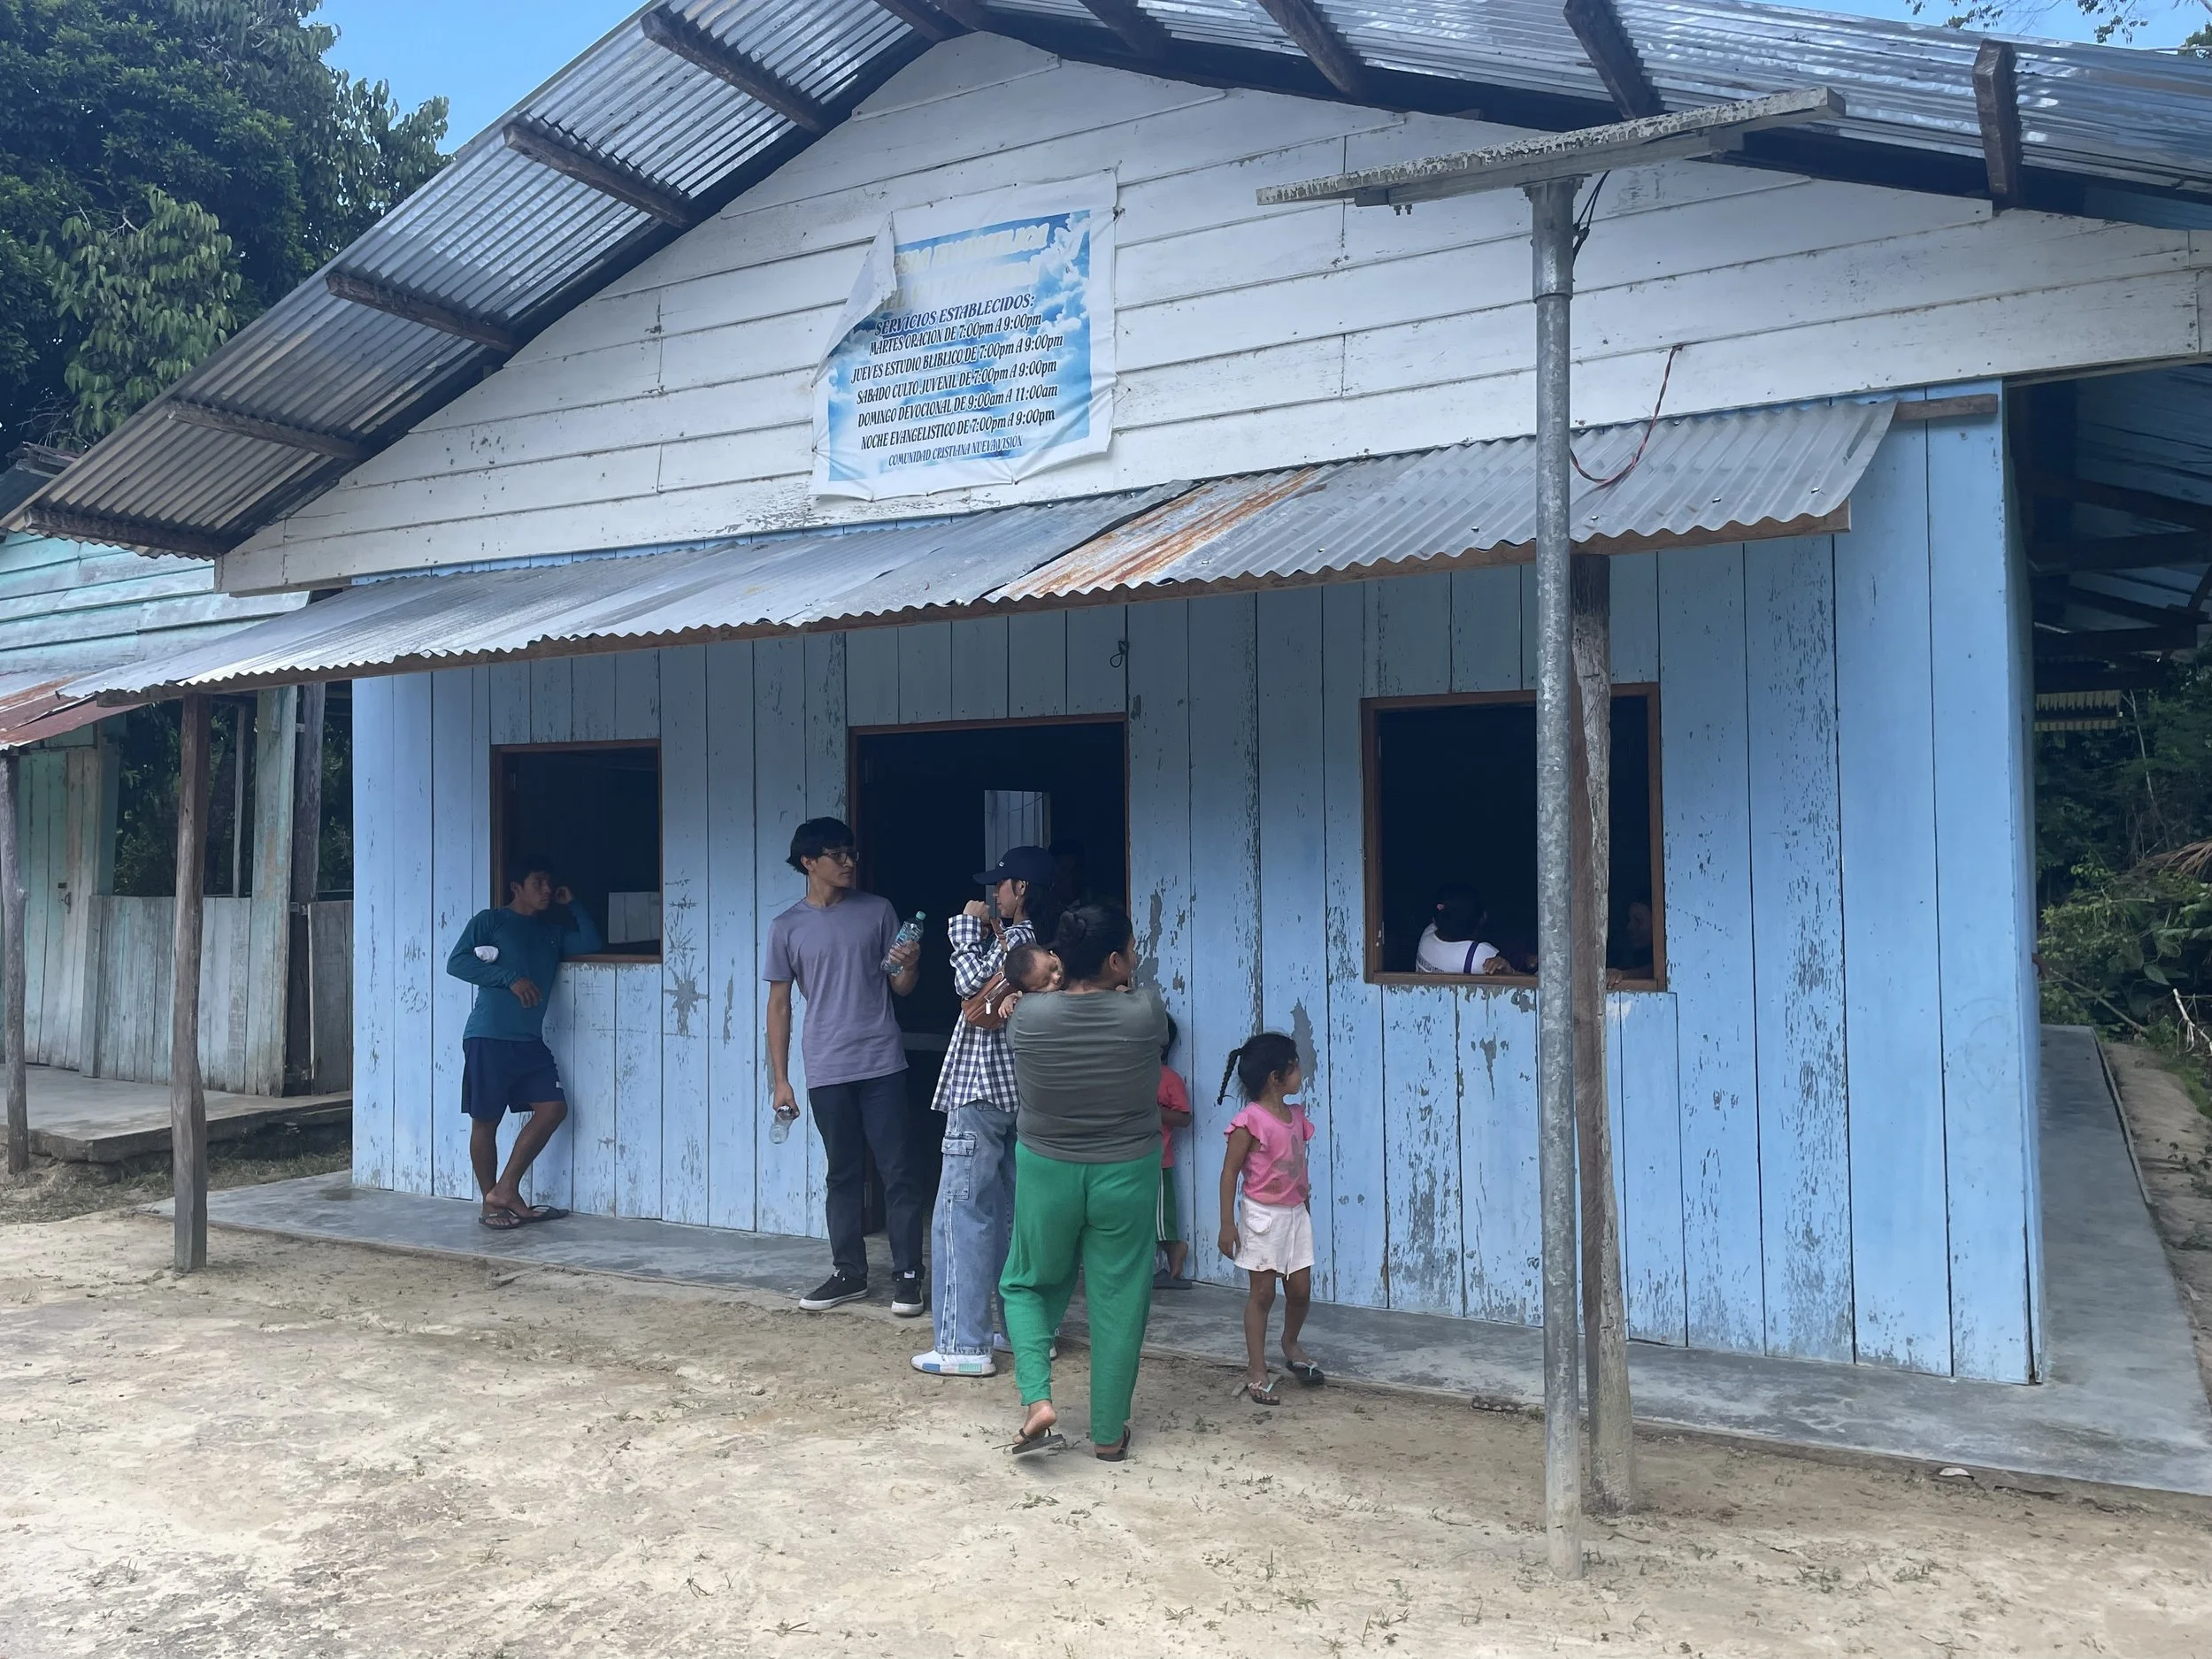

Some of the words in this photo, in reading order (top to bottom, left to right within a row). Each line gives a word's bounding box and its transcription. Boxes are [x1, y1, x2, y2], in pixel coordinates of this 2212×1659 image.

[869, 336, 903, 357] MARTES
[944, 326, 956, 343] DE
[959, 322, 994, 339] 7:00pm
[995, 318, 1003, 333] A
[1003, 313, 1042, 331] 9:00pm
[875, 311, 937, 336] SERVICIOS
[938, 293, 1035, 324] ESTABLECIDOS:
[850, 364, 884, 384] JUEVES
[885, 356, 921, 377] ESTUDIO
[964, 346, 978, 362] DE
[979, 342, 1015, 360] 7:00pm
[1015, 338, 1024, 353] A
[1025, 334, 1064, 352] 9:00pm
[856, 385, 891, 405] SABADO
[892, 380, 919, 399] CULTO
[919, 373, 957, 395] JUVENIL
[958, 371, 972, 388] DE
[973, 367, 1009, 385] 7:00pm
[1009, 364, 1018, 379] A
[1018, 359, 1057, 377] 9:00pm
[857, 408, 897, 428] DOMINGO
[898, 398, 952, 421] DEVOCIONAL
[954, 396, 967, 411] DE
[968, 392, 1004, 410] 9:00am
[1005, 388, 1013, 403] A
[1015, 384, 1058, 402] 11:00am
[861, 432, 889, 449] NOCHE
[889, 421, 956, 446] EVANGELISTICO
[956, 419, 971, 435] DE
[972, 416, 1006, 433] 7:00pm
[1007, 412, 1015, 427] A
[1016, 408, 1056, 426] 9:00pm
[888, 449, 932, 467] COMUNIDAD
[932, 442, 972, 460] CRISTIANA
[972, 438, 996, 454] NUEVA
